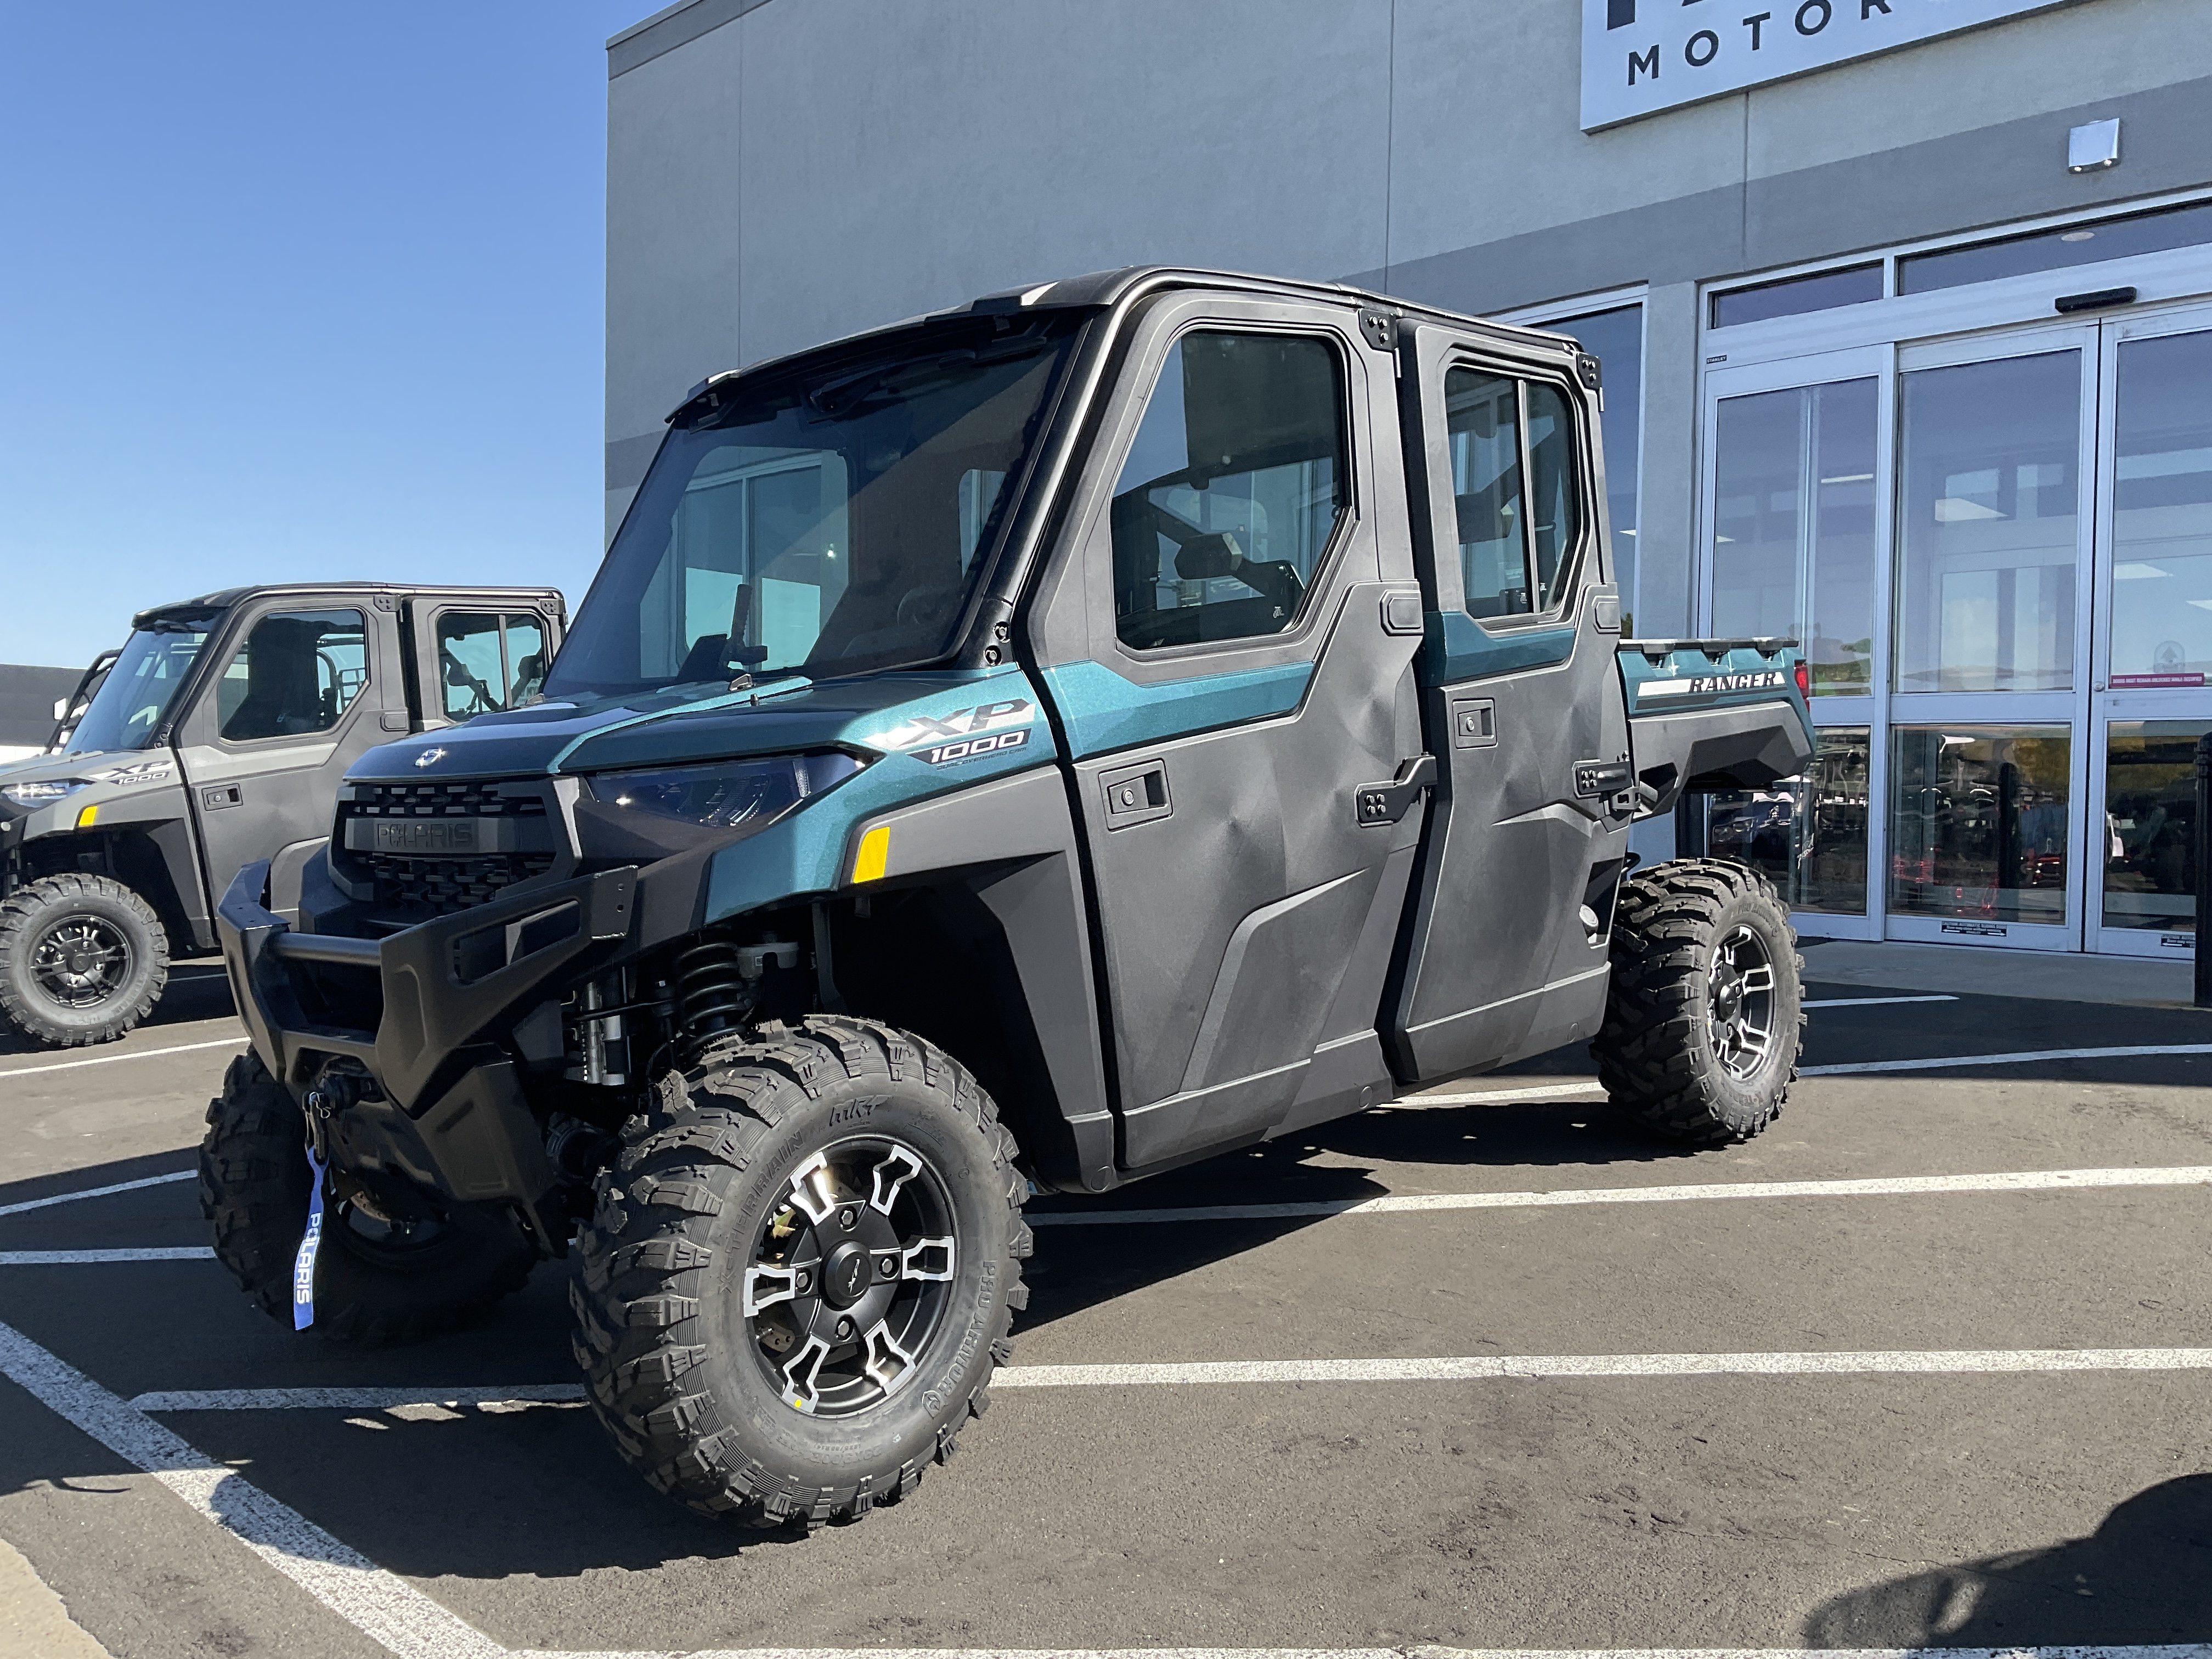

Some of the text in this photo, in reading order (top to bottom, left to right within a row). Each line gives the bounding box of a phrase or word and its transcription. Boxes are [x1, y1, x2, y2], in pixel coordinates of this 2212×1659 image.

[1689, 672, 1776, 693] RANGER
[896, 698, 1031, 747] XP
[932, 731, 1025, 763] 1000
[961, 751, 1007, 765] OVERHEAD
[1009, 747, 1027, 755] CAM
[104, 760, 172, 778] XP
[119, 771, 166, 785] 1000
[377, 823, 473, 849] POLARIS
[718, 1130, 804, 1295] X-TERRAIN
[296, 1212, 321, 1304] POLARIS
[938, 1260, 997, 1397] PRO ARMOR
